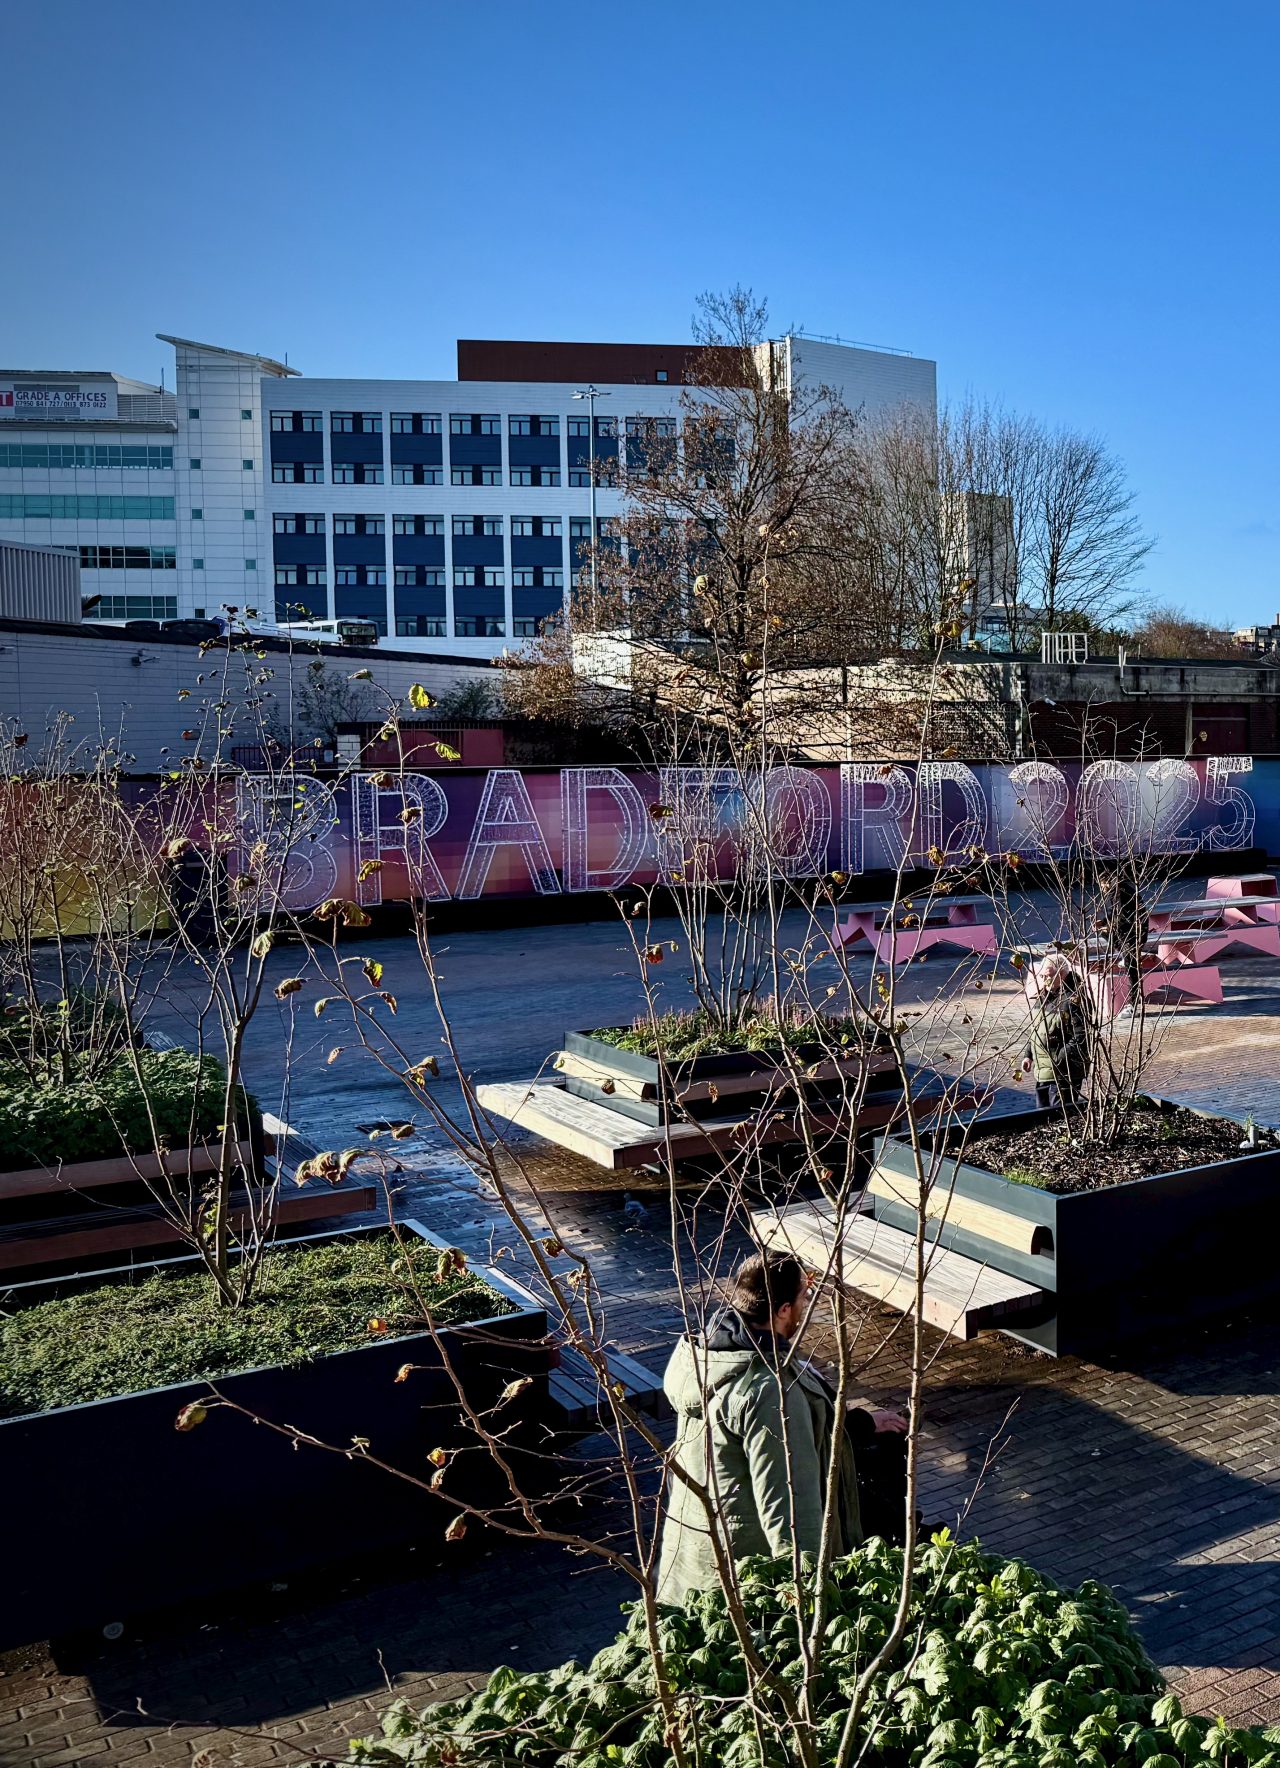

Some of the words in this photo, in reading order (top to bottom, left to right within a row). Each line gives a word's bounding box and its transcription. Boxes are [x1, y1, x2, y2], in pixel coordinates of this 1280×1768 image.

[16, 391, 50, 401] GRADE
[53, 392, 60, 401] A
[64, 392, 107, 402] OFFICES
[235, 761, 988, 912] BRADFORD
[1008, 756, 1256, 860] 2025
